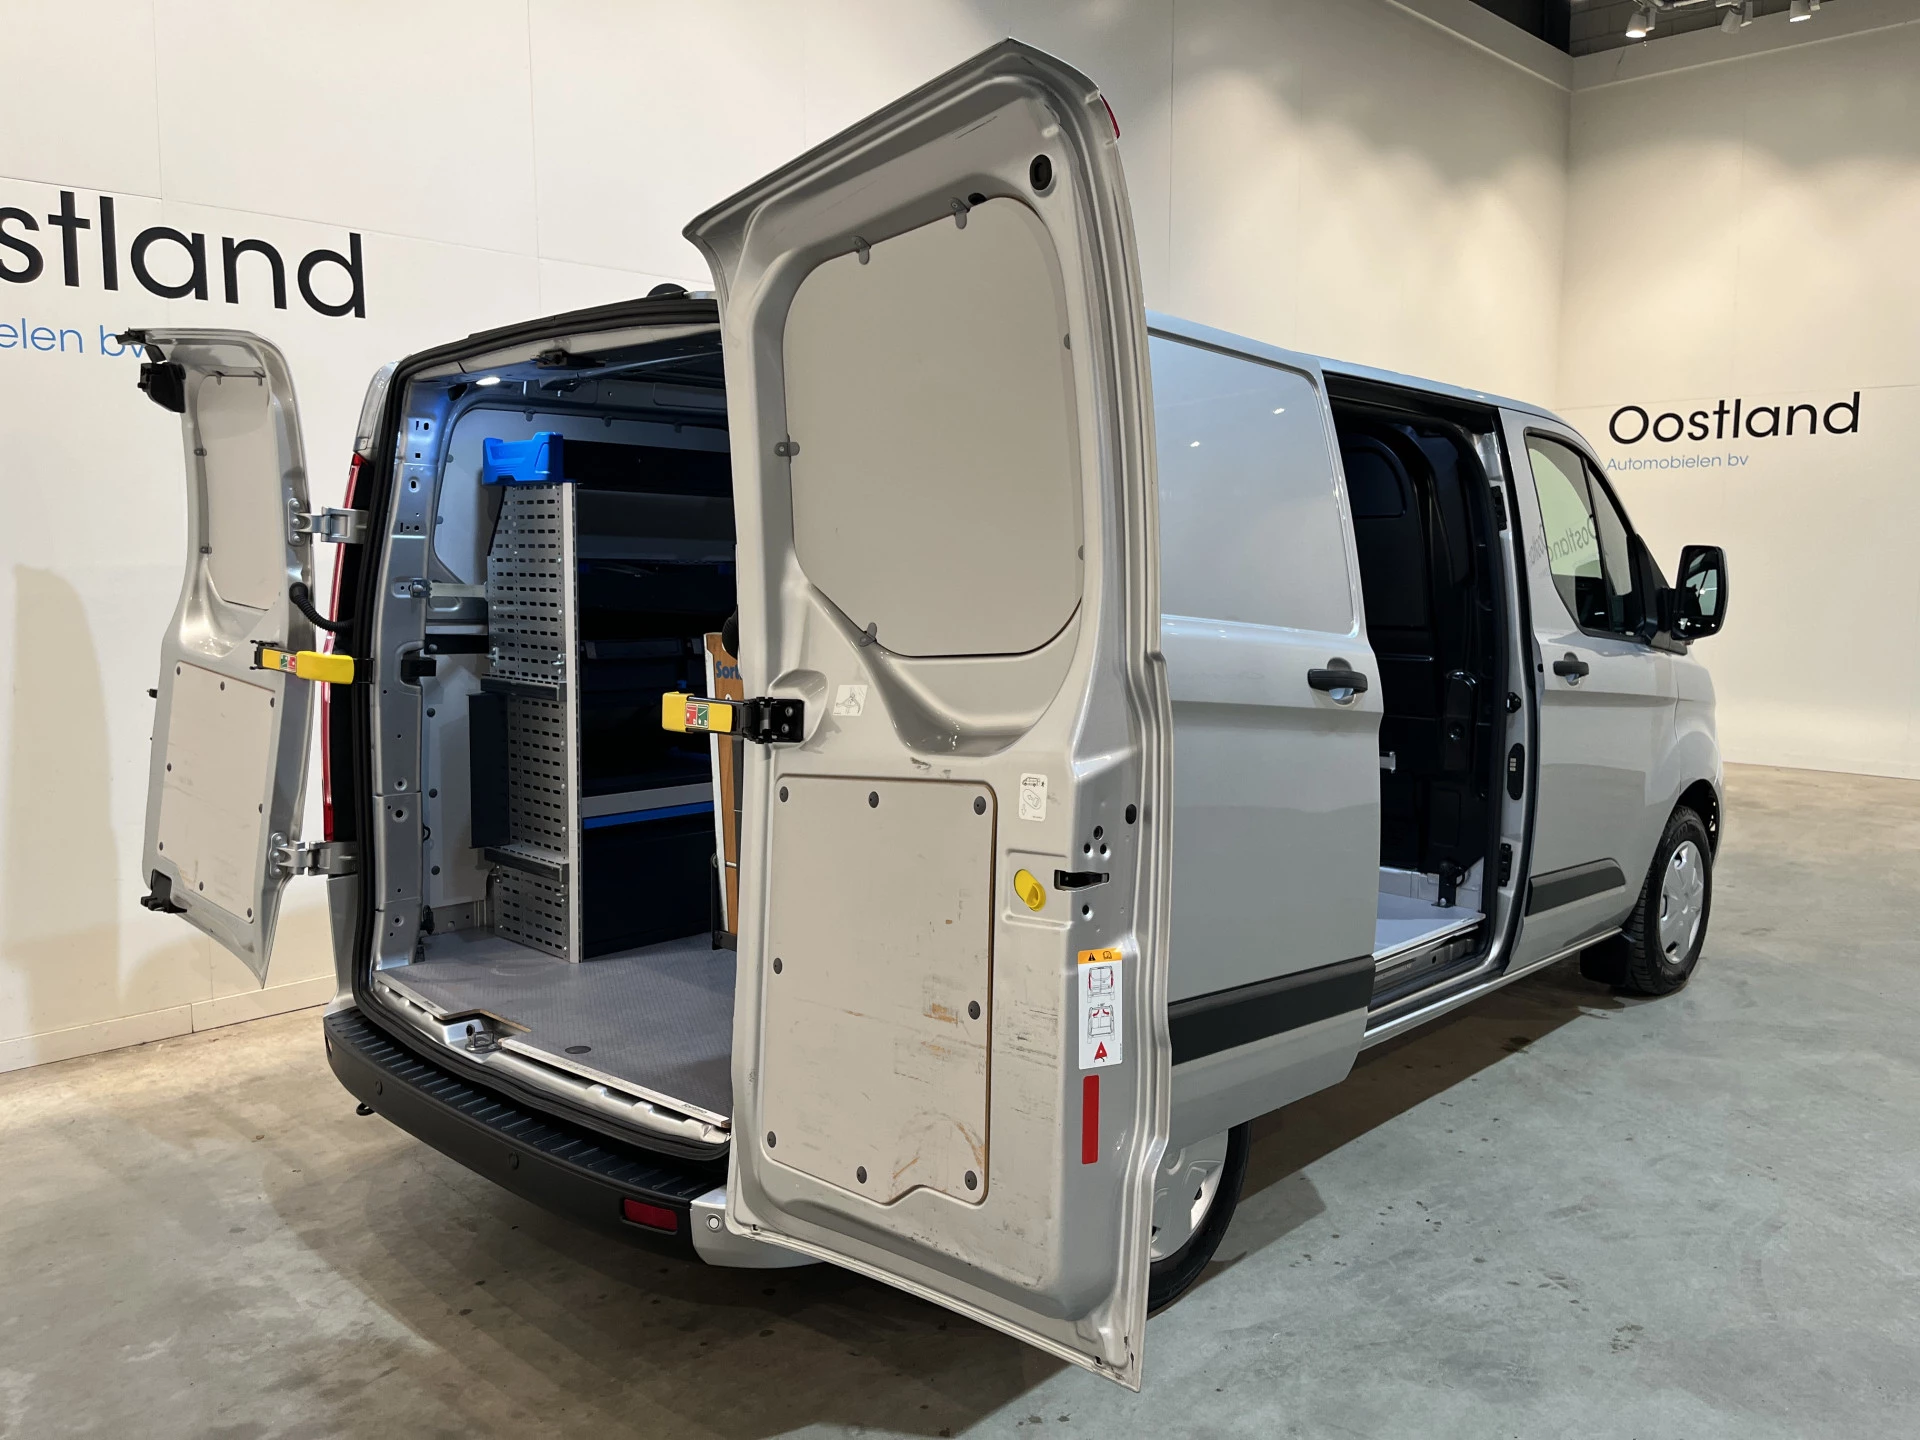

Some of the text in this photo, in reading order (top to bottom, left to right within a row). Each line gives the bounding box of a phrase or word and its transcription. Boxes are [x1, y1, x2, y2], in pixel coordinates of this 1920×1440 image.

[1609, 391, 1860, 445] Oostland
[1606, 453, 1749, 471] Automobielen bv
